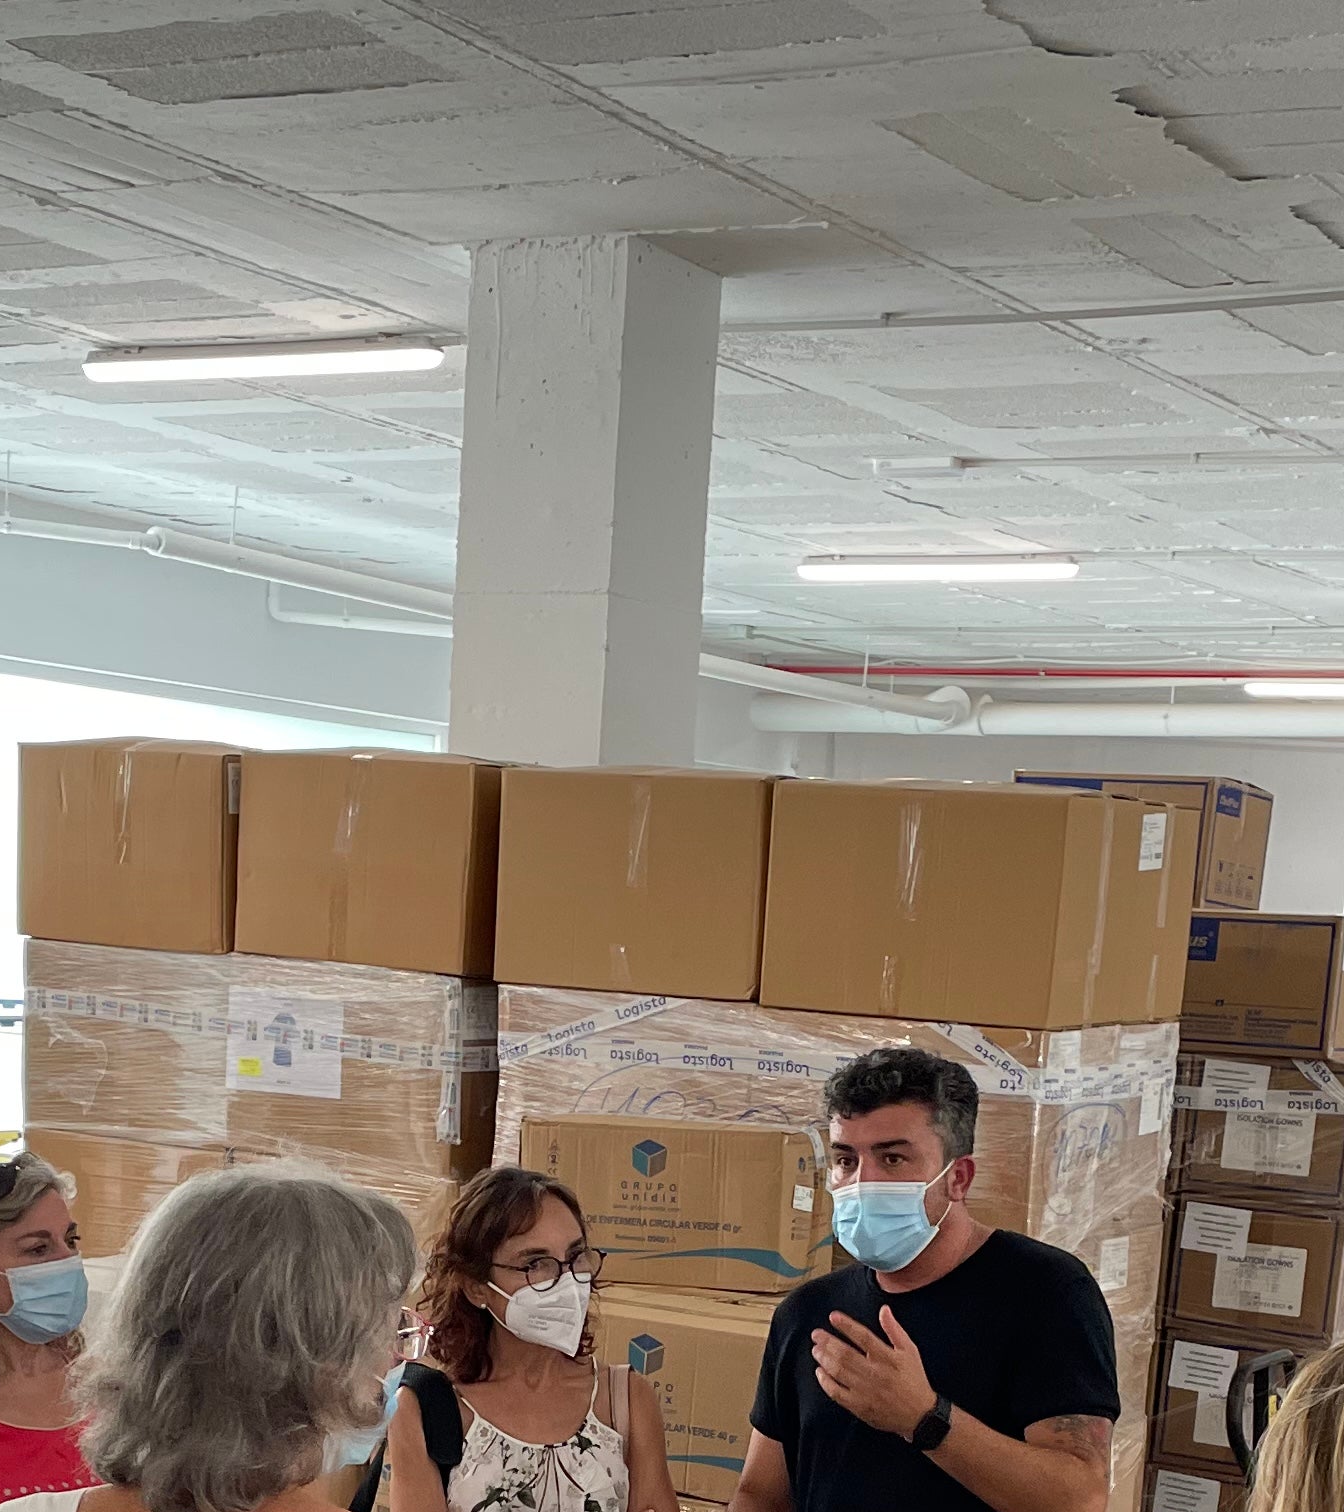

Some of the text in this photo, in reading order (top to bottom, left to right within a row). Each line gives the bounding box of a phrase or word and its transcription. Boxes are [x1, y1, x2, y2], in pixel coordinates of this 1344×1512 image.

[614, 996, 667, 1021] Logista
[610, 1049, 661, 1065] Logista
[682, 1053, 734, 1071] Logista
[757, 1059, 810, 1077] Logista
[1214, 1096, 1265, 1111] Logista
[1287, 1098, 1339, 1113] Logista
[620, 1181, 677, 1192] GRUPO
[621, 1192, 677, 1203] unidix
[599, 1214, 648, 1228] ENFERMERA
[649, 1219, 691, 1230] CIRCULAR
[692, 1221, 720, 1232] VERDE
